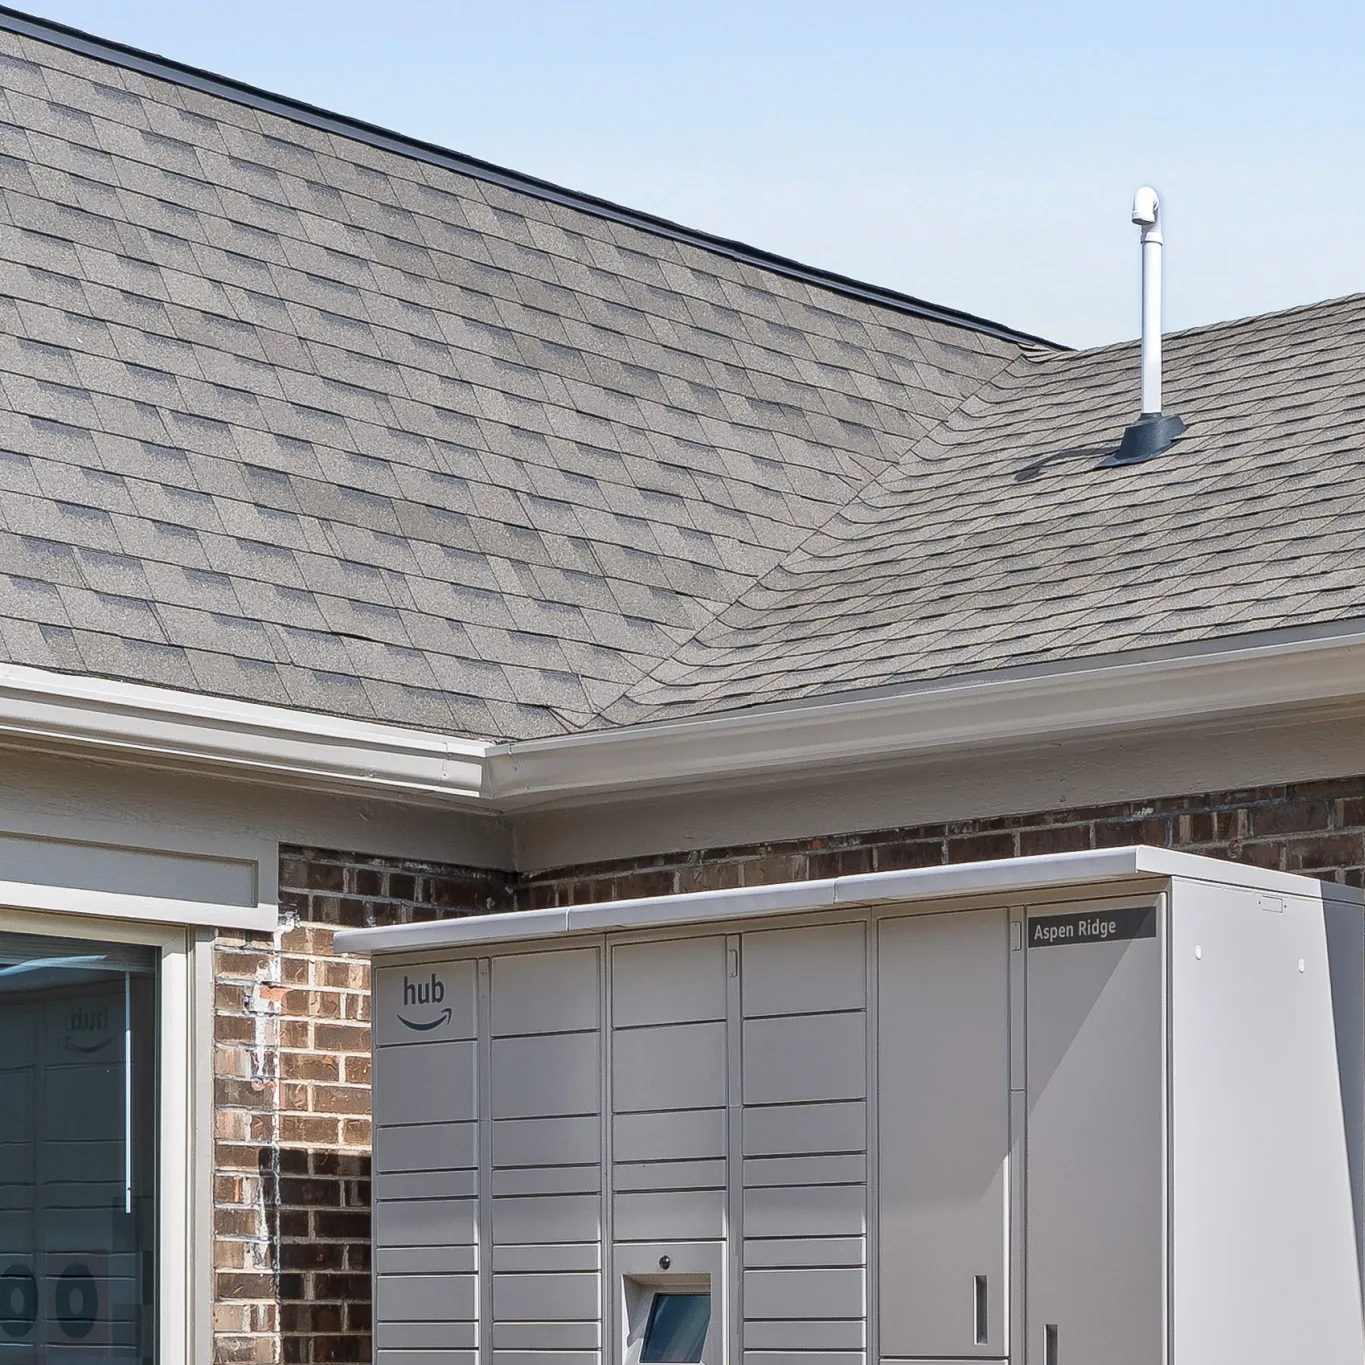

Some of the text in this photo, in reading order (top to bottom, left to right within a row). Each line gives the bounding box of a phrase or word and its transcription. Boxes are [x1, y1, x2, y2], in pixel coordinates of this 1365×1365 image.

[1033, 918, 1117, 942] Aspen Ridge
[403, 973, 445, 1006] hub
